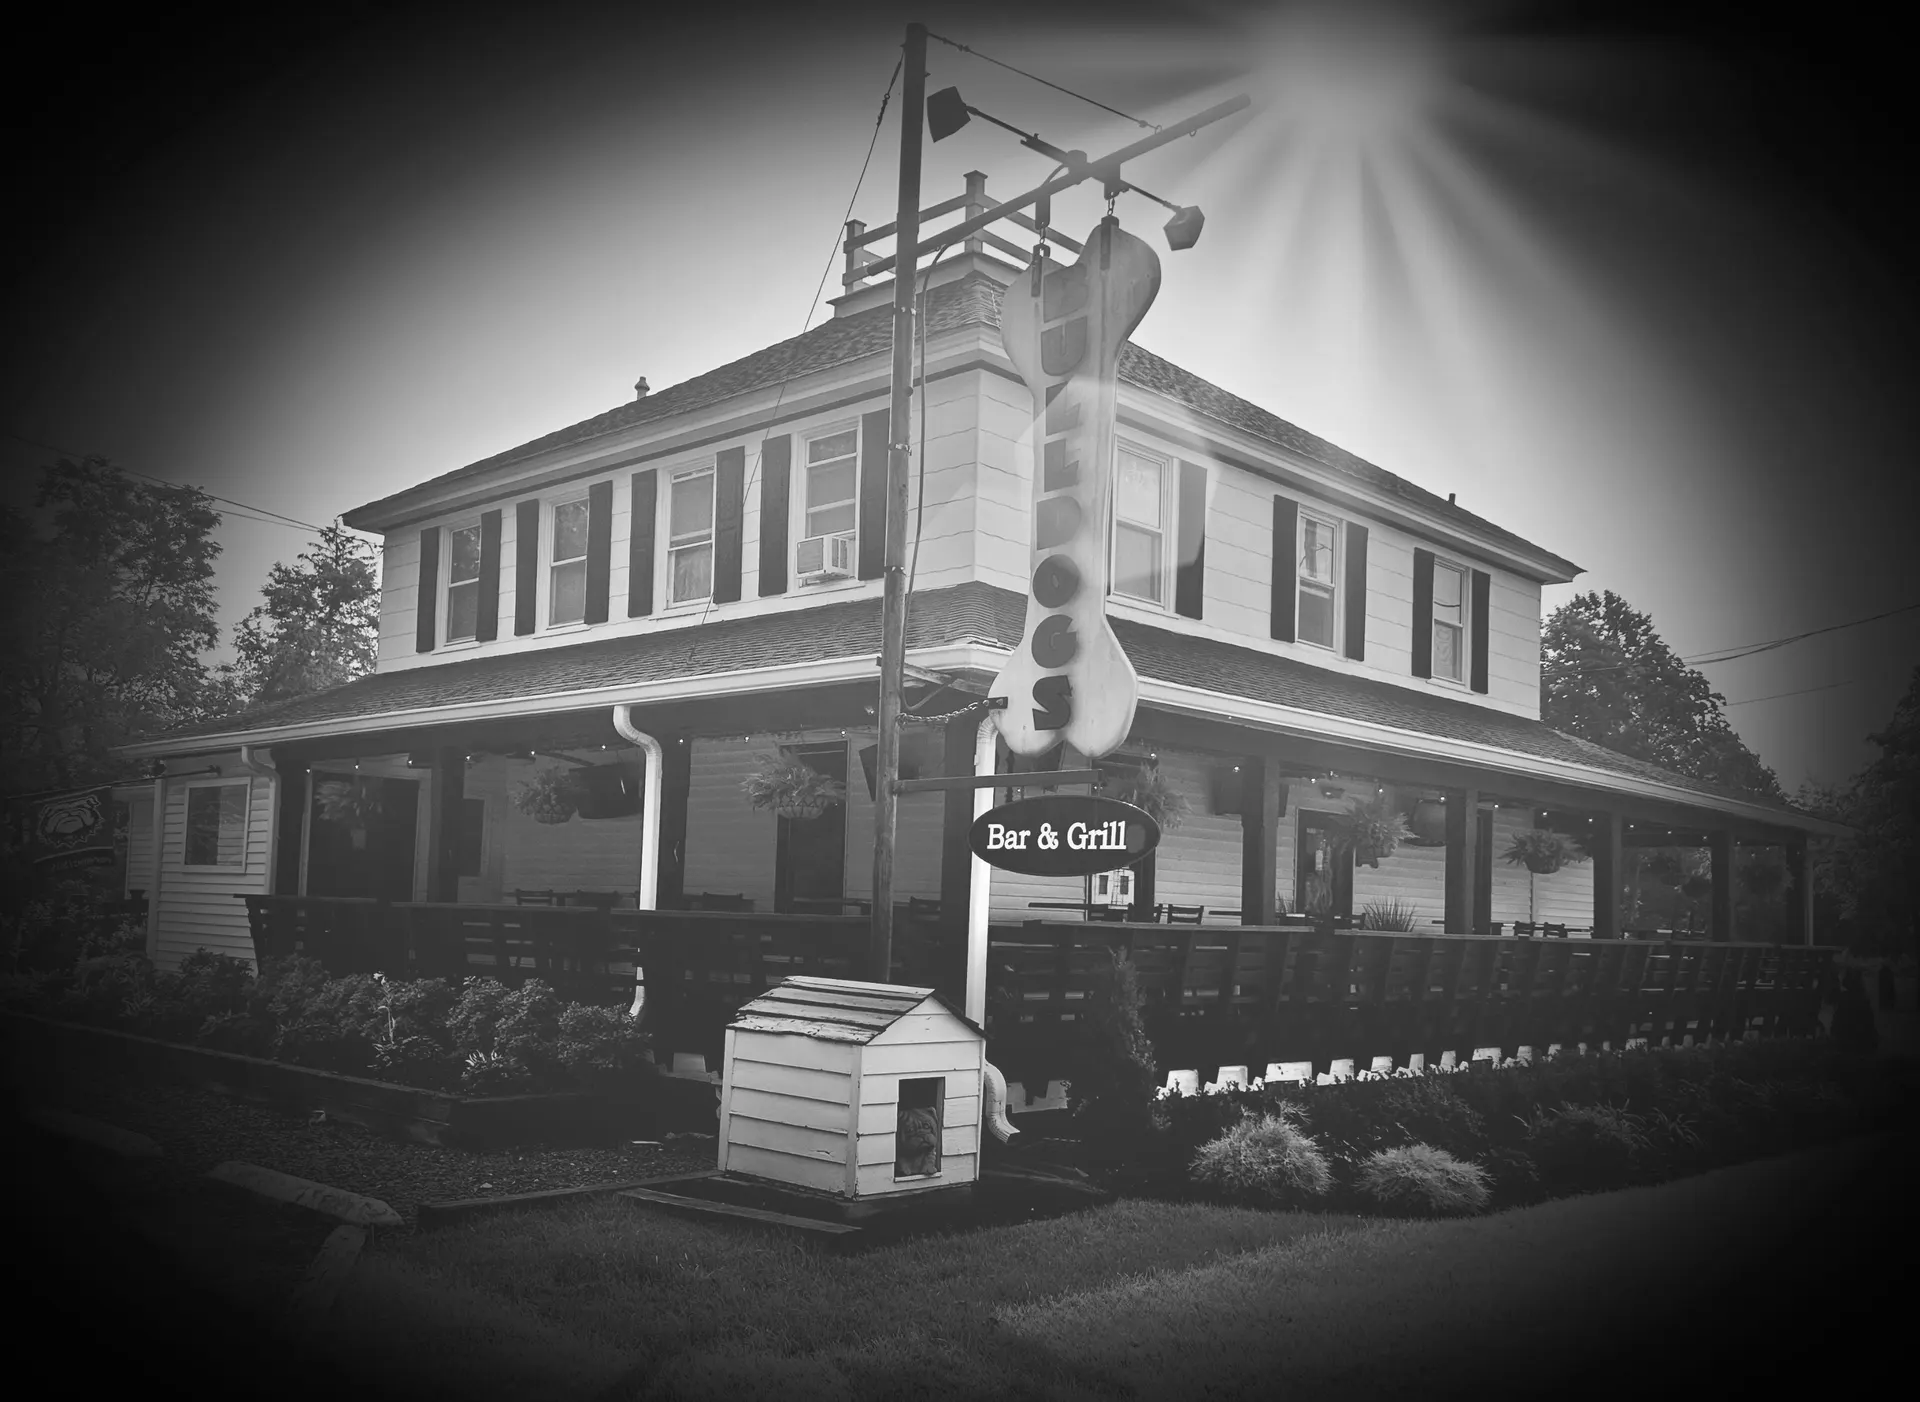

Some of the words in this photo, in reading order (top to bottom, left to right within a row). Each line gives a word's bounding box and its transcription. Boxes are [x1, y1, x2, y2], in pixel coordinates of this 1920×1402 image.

[1031, 263, 1089, 731] BULLDOGS
[986, 823, 1031, 850] Bar
[1037, 822, 1059, 850] &
[1067, 820, 1127, 850] Grill
